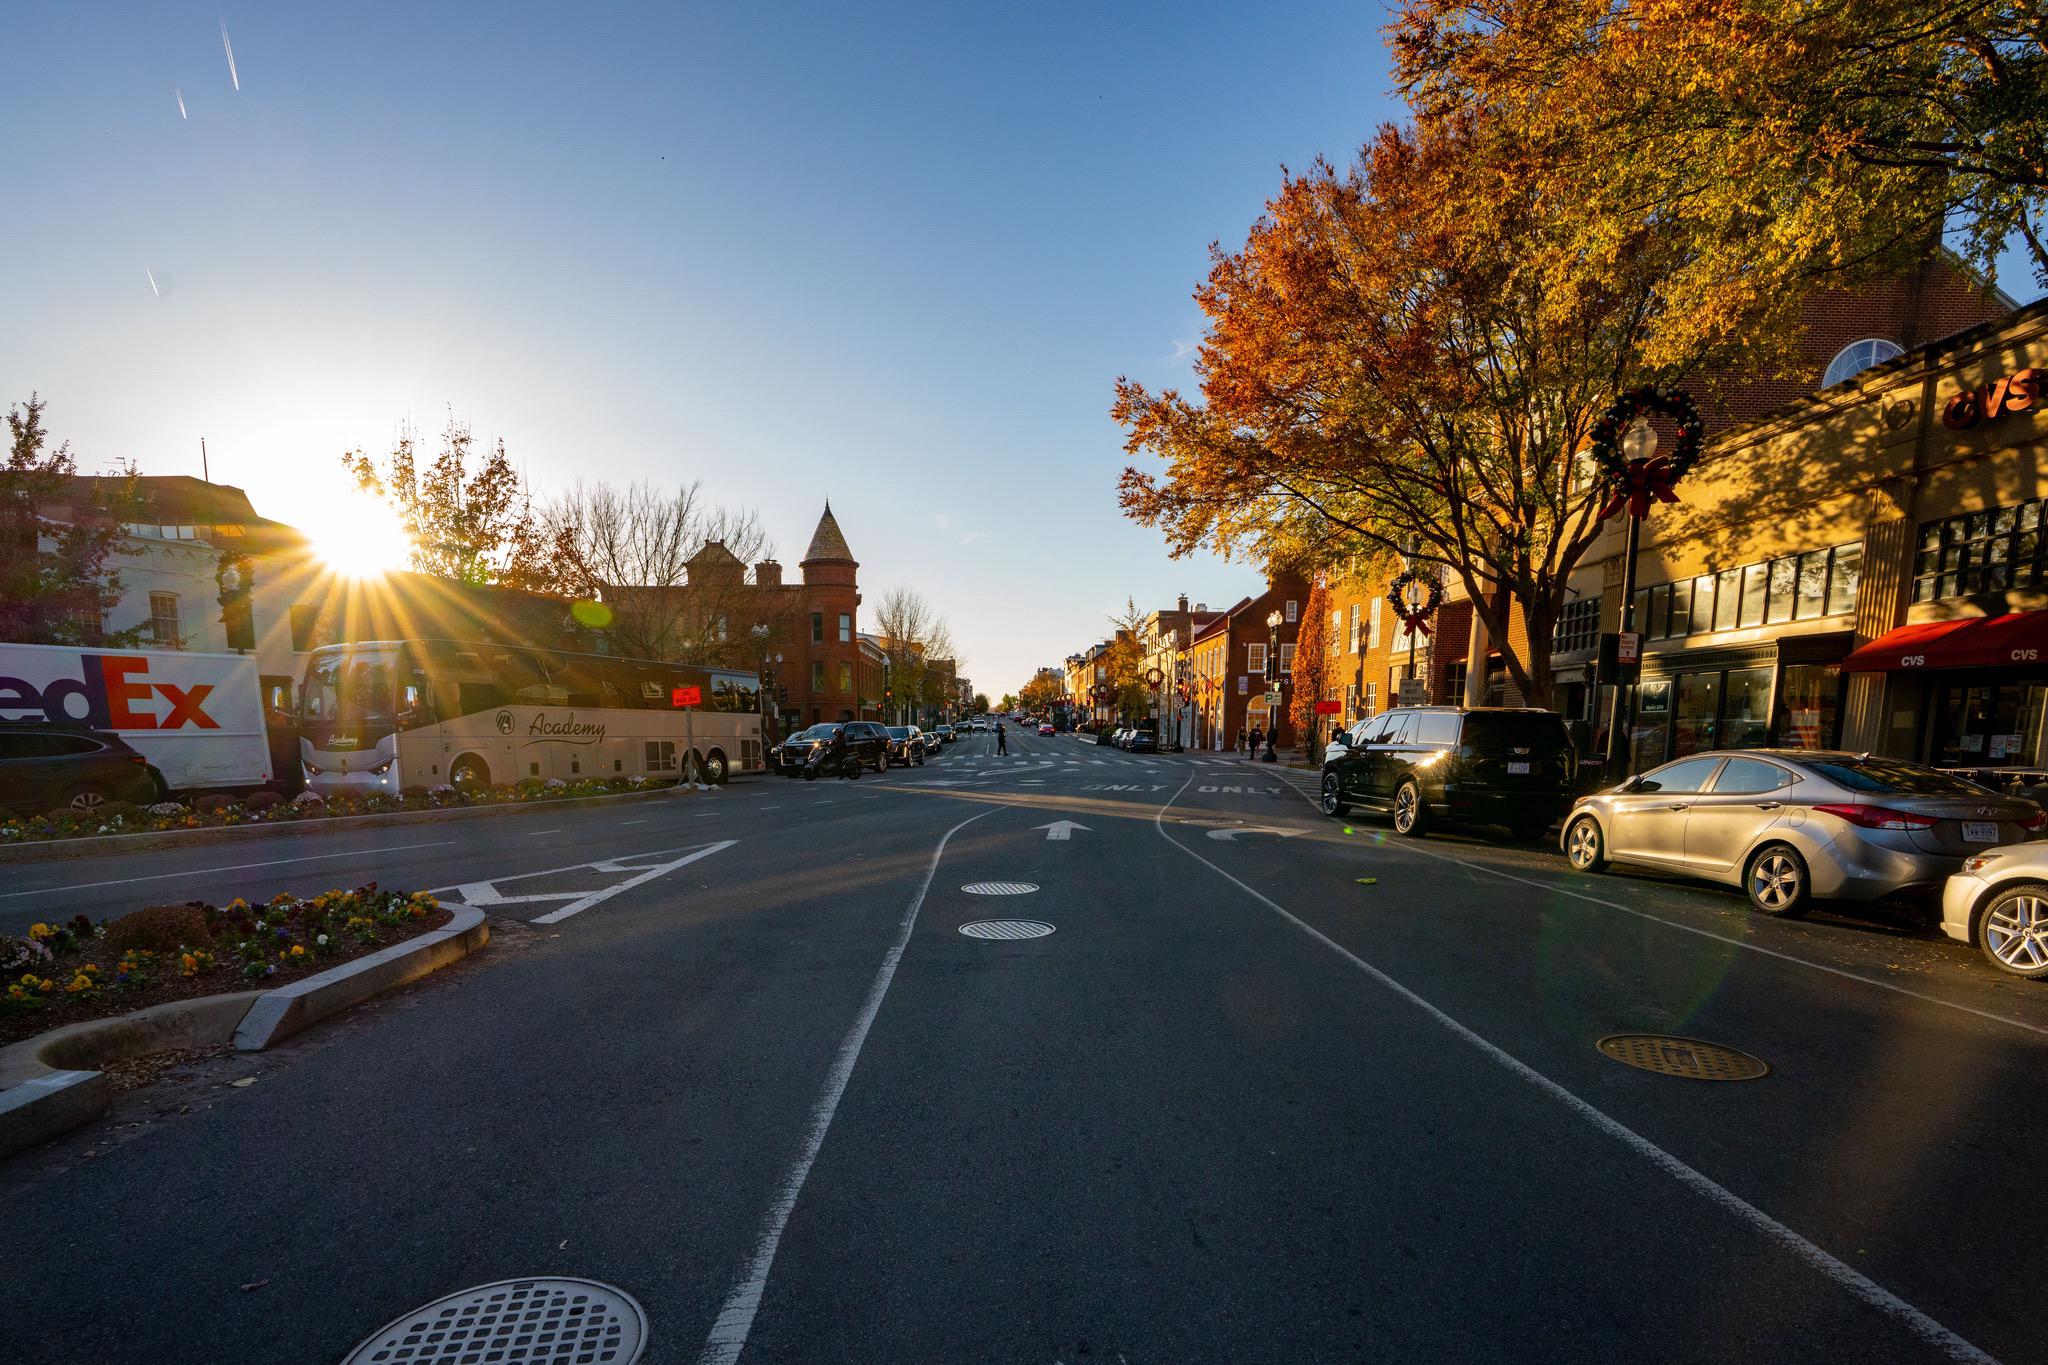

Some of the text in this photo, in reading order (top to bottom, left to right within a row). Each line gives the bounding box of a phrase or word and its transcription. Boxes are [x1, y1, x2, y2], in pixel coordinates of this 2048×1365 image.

[1942, 367, 2036, 429] CVS
[1901, 655, 1925, 667] CVS
[2010, 649, 2038, 661] CVS
[0, 654, 222, 730] edEx
[528, 711, 607, 744] Academy
[327, 733, 359, 746] Academy
[1080, 784, 1168, 792] ONLY
[1198, 785, 1283, 794] ONLY
